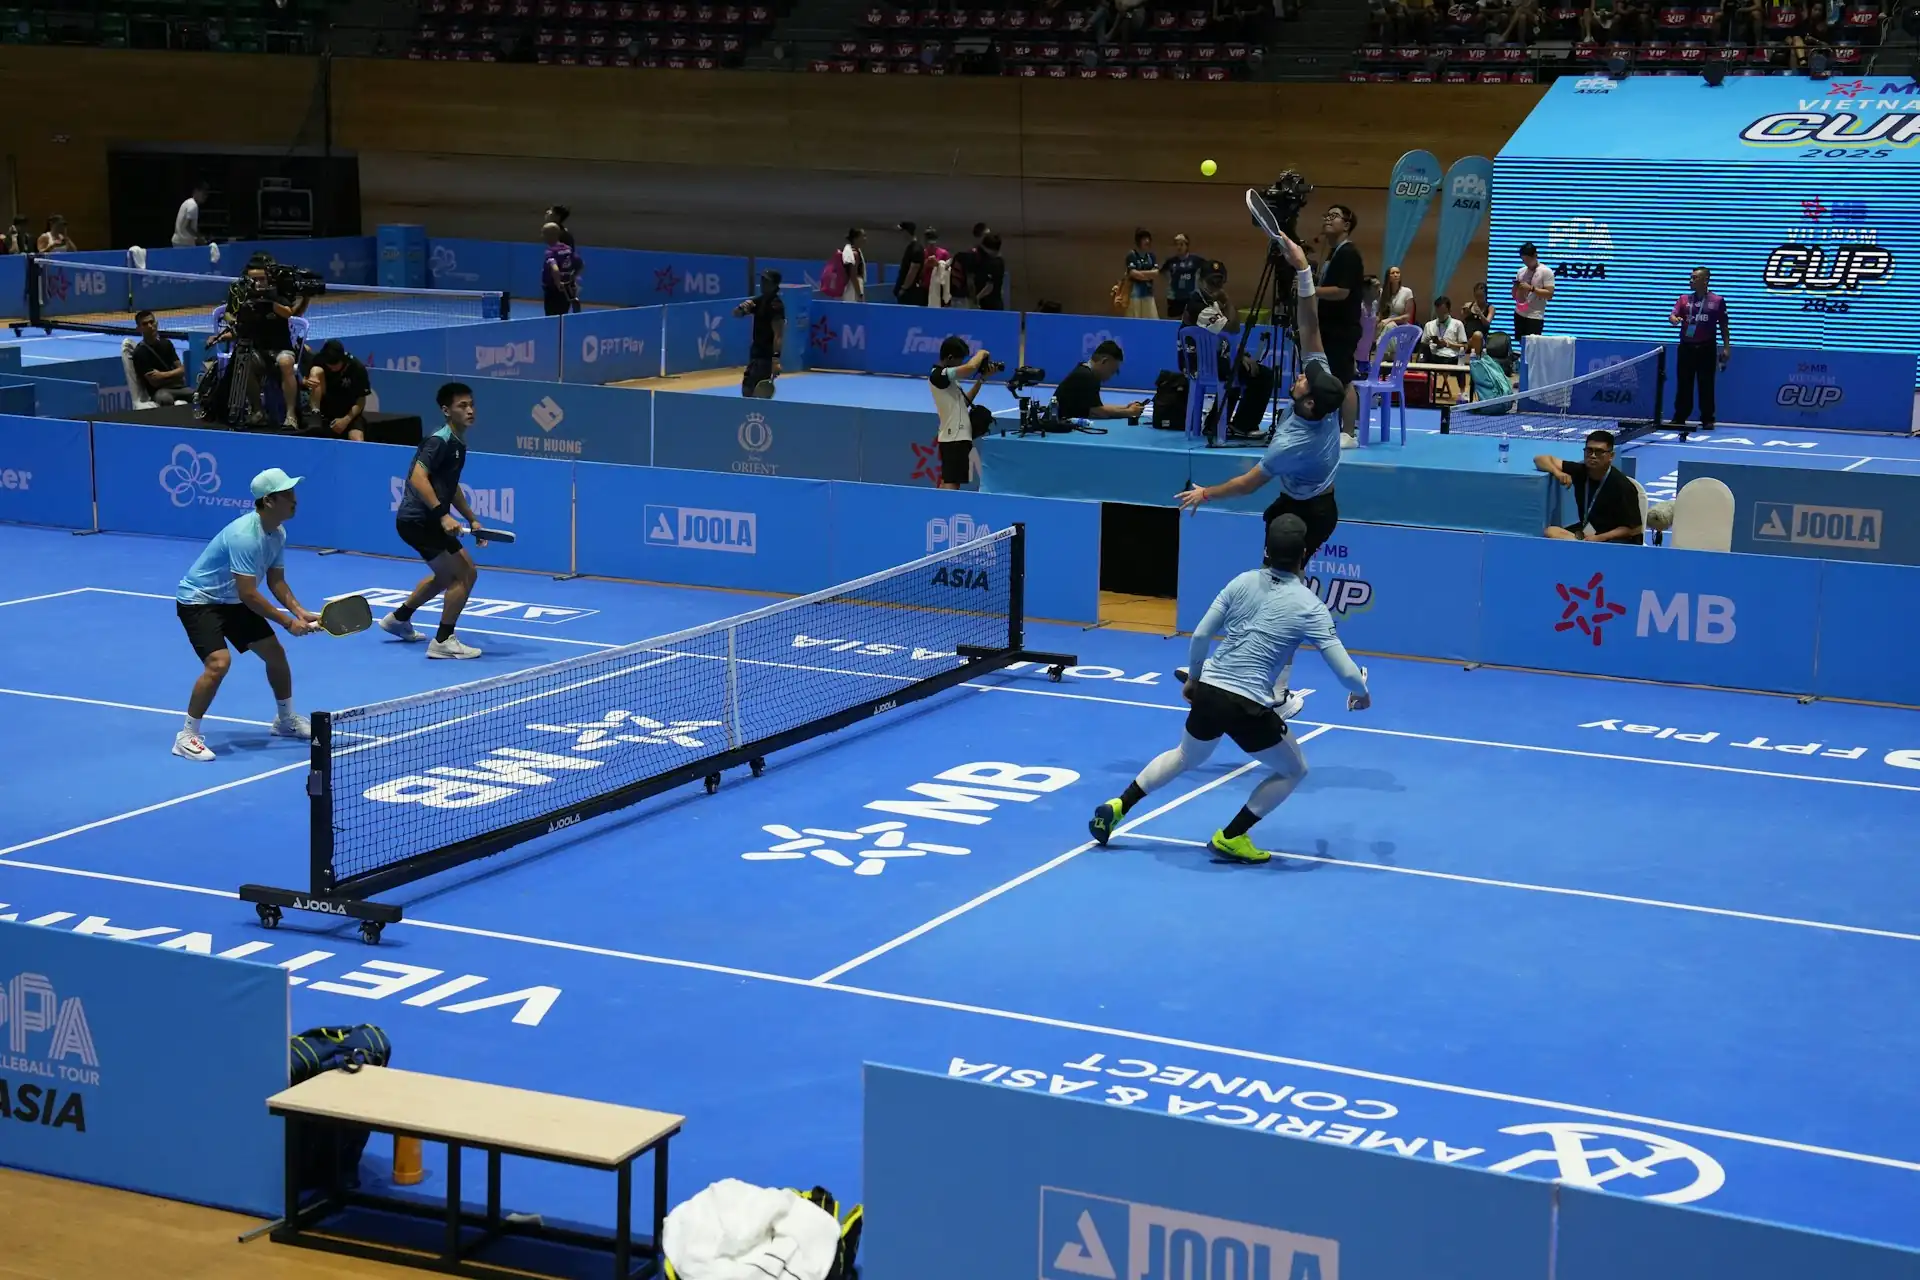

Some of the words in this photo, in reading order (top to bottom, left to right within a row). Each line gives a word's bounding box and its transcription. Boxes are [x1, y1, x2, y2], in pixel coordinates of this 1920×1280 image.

[1879, 83, 1920, 94] M
[1799, 149, 1894, 158] 2025
[1395, 182, 1431, 197] CUP
[1453, 198, 1480, 209] ASIA
[1553, 262, 1606, 279] ASIA
[1764, 244, 1892, 290] CUP
[75, 272, 107, 296] MB
[684, 272, 721, 295] MB
[601, 339, 621, 356] FPT
[623, 336, 645, 356] Play
[1591, 389, 1632, 404] ASIA
[1776, 383, 1843, 408] CUP
[0, 468, 32, 490] er
[731, 461, 778, 475] ORIENT
[682, 515, 753, 547] JOOLA
[1796, 511, 1877, 543] JOOLA
[1324, 543, 1349, 558] MB
[930, 566, 990, 592] ASIA
[1303, 575, 1373, 616] UP
[1636, 589, 1737, 645] MB
[1577, 719, 1721, 745] Play
[1729, 736, 1869, 760] FPT
[362, 747, 606, 810] MB
[864, 760, 1081, 826] MB
[554, 813, 581, 831] JOOLA
[303, 899, 347, 915] JOOLA
[58, 1064, 100, 1086] TOUR
[946, 1056, 1099, 1096] ASIA
[1063, 1052, 1399, 1121] CONNECT
[1167, 1094, 1487, 1164] AMERICA
